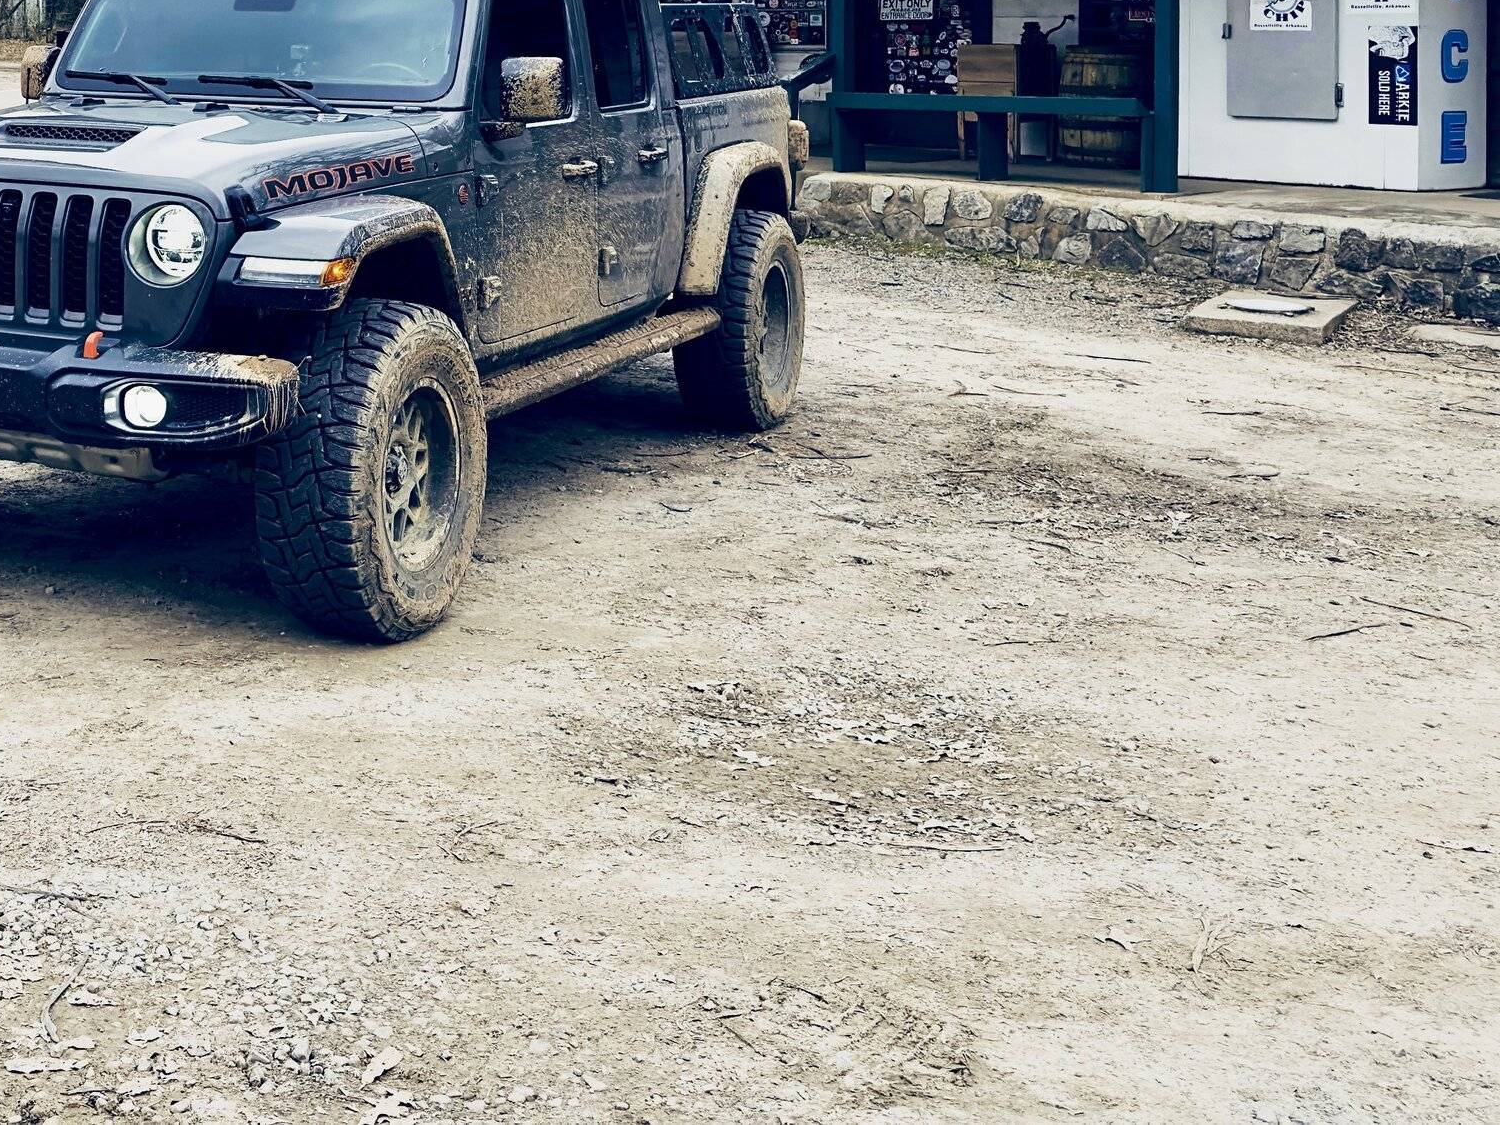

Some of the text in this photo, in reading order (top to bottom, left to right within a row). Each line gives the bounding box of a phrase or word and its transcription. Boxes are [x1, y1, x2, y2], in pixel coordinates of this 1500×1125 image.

[882, 0, 905, 9] EXIT
[1263, 0, 1305, 22] CHIP
[1378, 70, 1391, 116] SOLD HERE
[1396, 81, 1410, 122] ARKIE
[263, 153, 415, 201] MOJAVE
